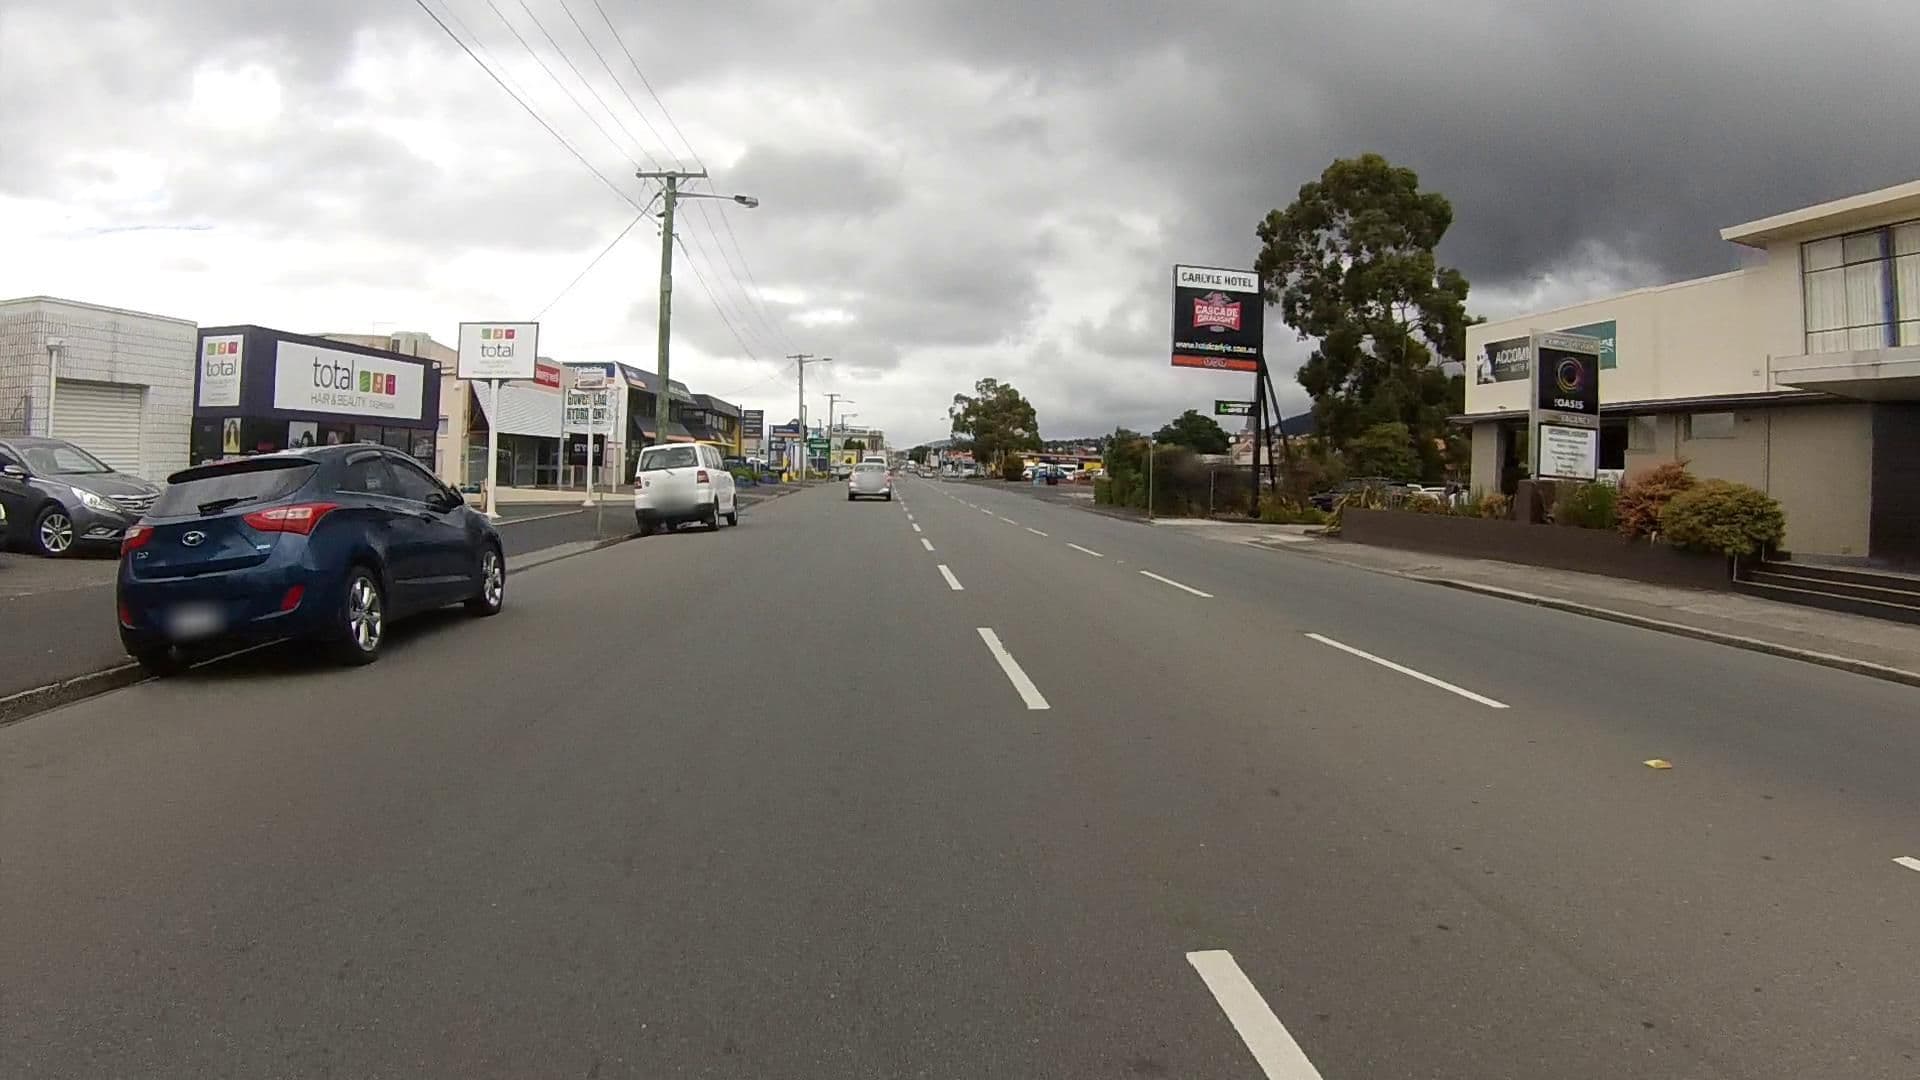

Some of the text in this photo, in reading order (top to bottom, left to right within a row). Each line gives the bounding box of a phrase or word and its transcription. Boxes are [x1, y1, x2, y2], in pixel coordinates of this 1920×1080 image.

[1182, 271, 1253, 288] CARLYLE HOTEL
[1195, 304, 1239, 318] CASCADE
[480, 343, 515, 358] total
[206, 358, 237, 377] total
[312, 356, 355, 391] total
[310, 392, 330, 405] HAIR
[337, 394, 366, 408] BEAUTY
